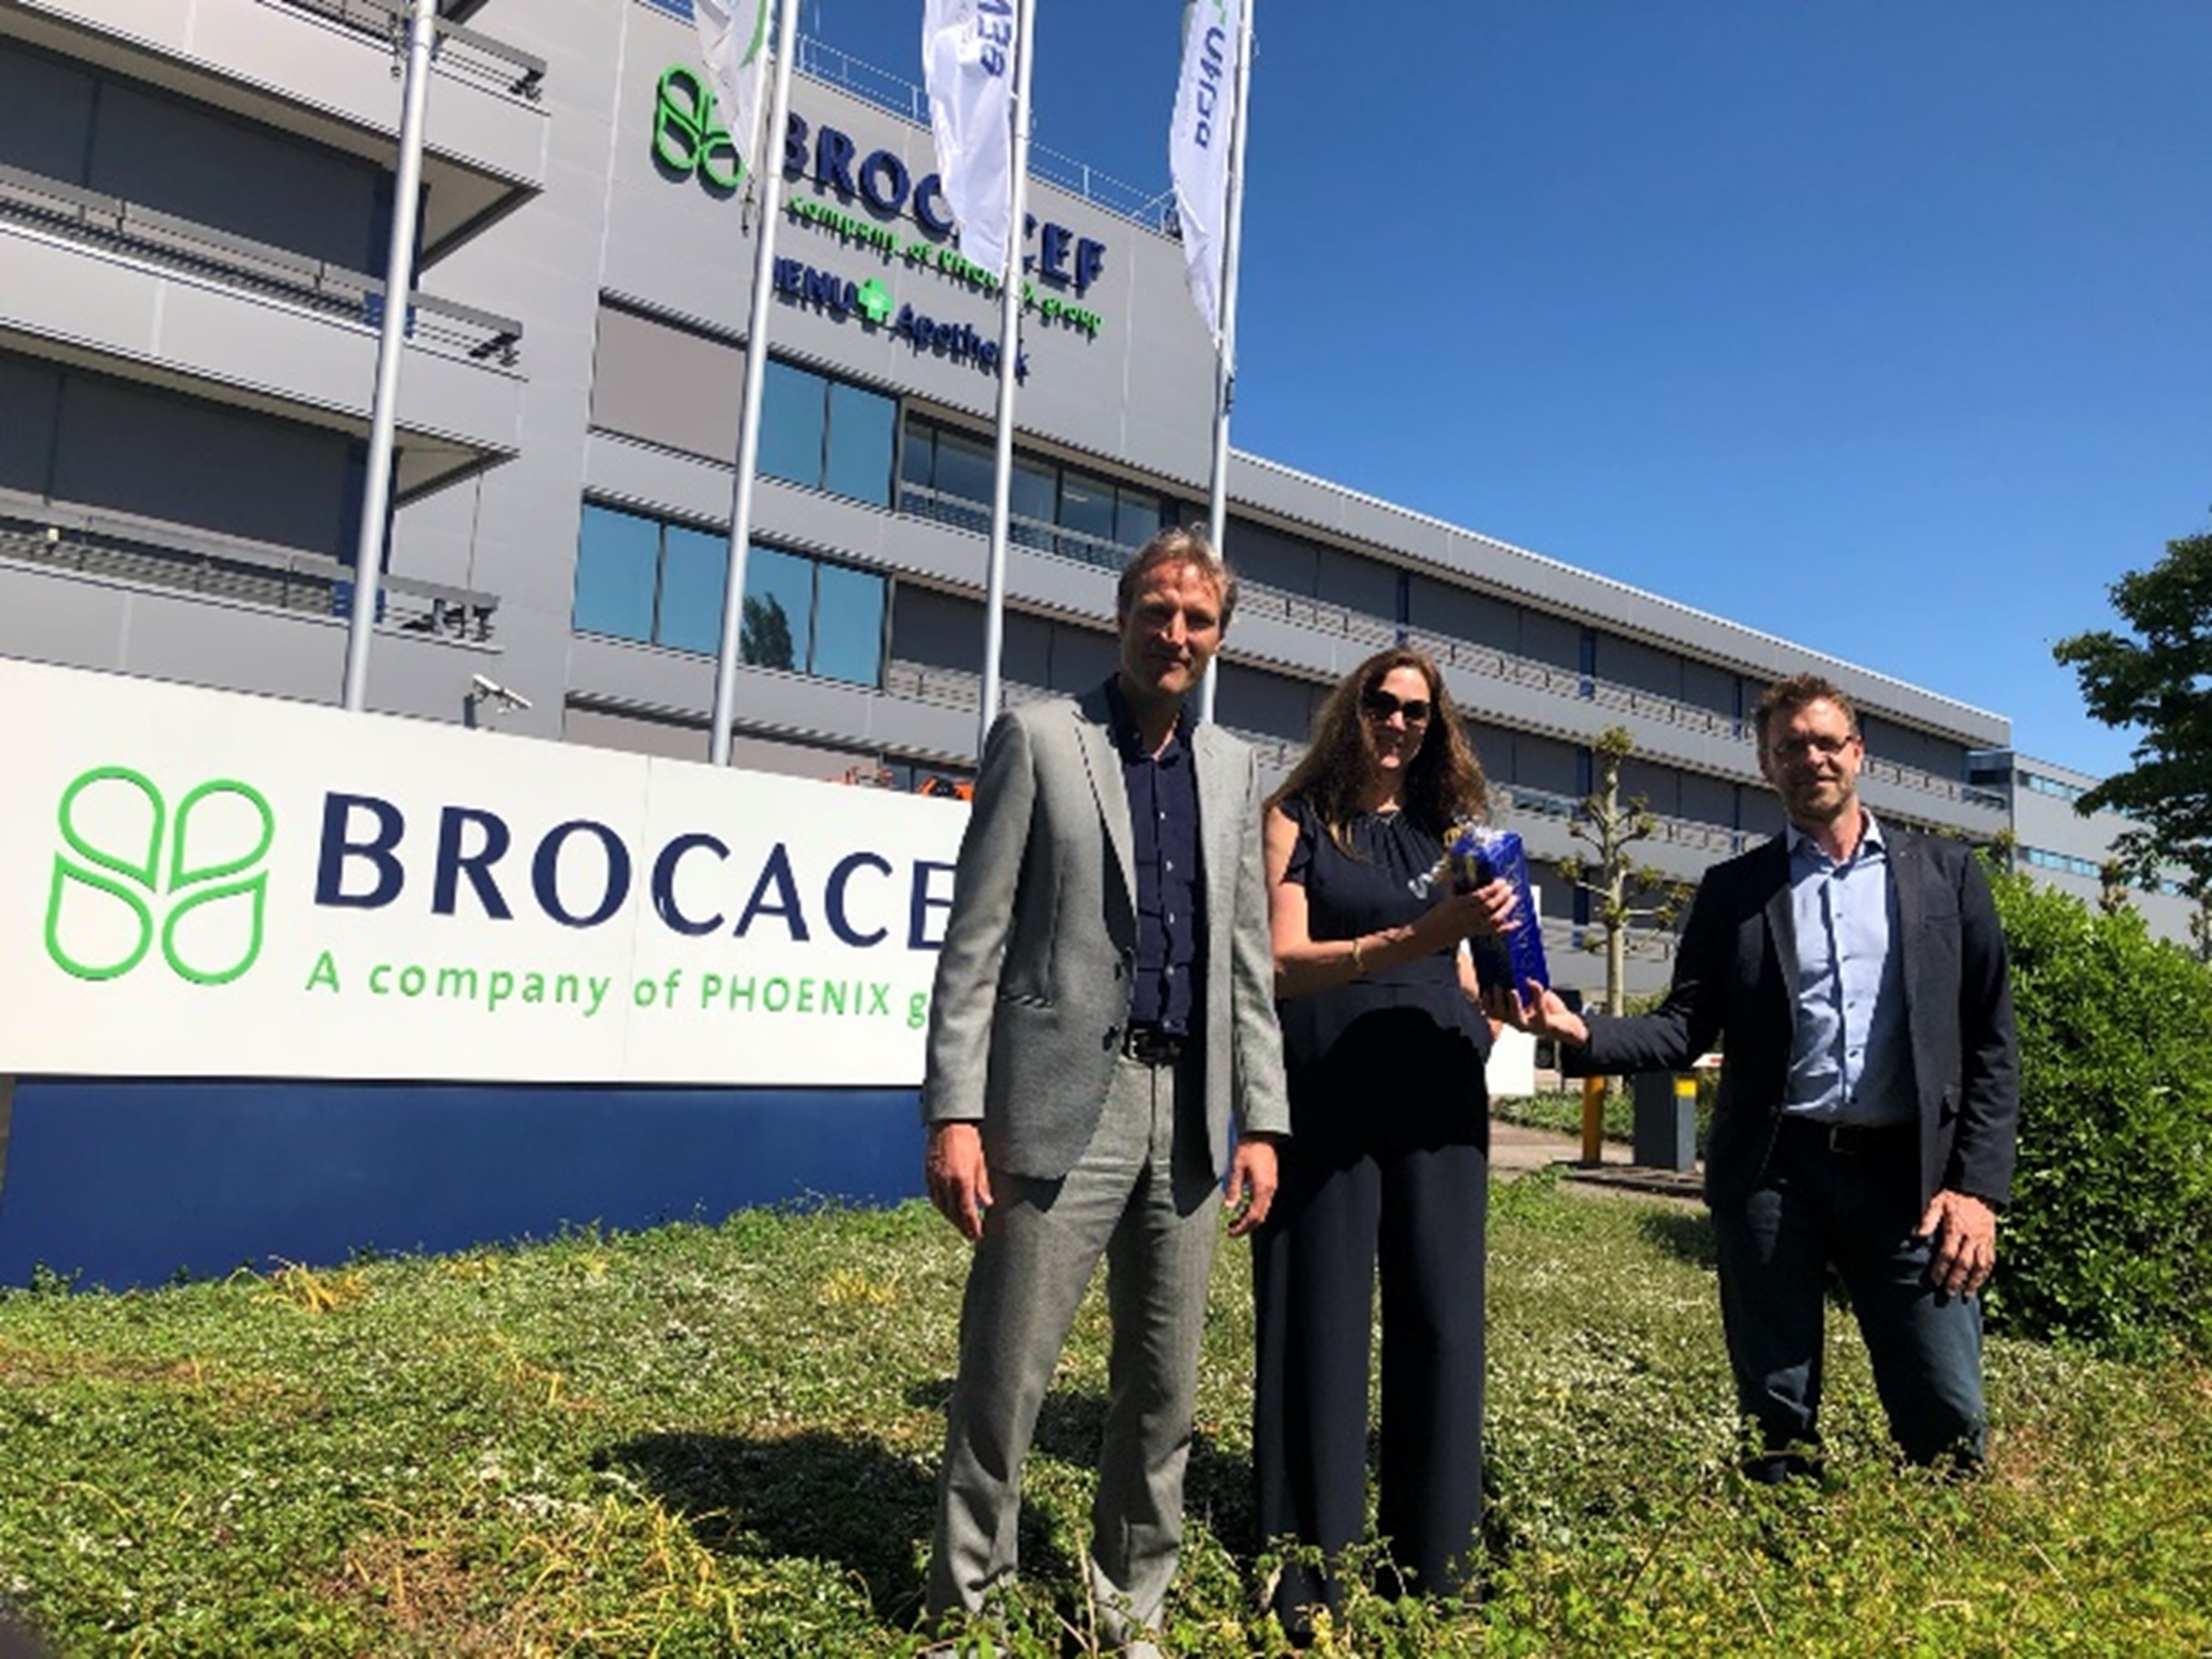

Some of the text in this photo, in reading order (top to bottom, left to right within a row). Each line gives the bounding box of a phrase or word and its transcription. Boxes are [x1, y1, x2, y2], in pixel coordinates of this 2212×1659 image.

[784, 109, 1106, 286] BROCEF
[895, 302, 1028, 378] Apothek
[314, 791, 958, 950] BROCACE
[305, 949, 340, 992] A
[369, 963, 610, 1018] company
[634, 969, 681, 1009] of
[701, 971, 890, 1015] PHOENIX
